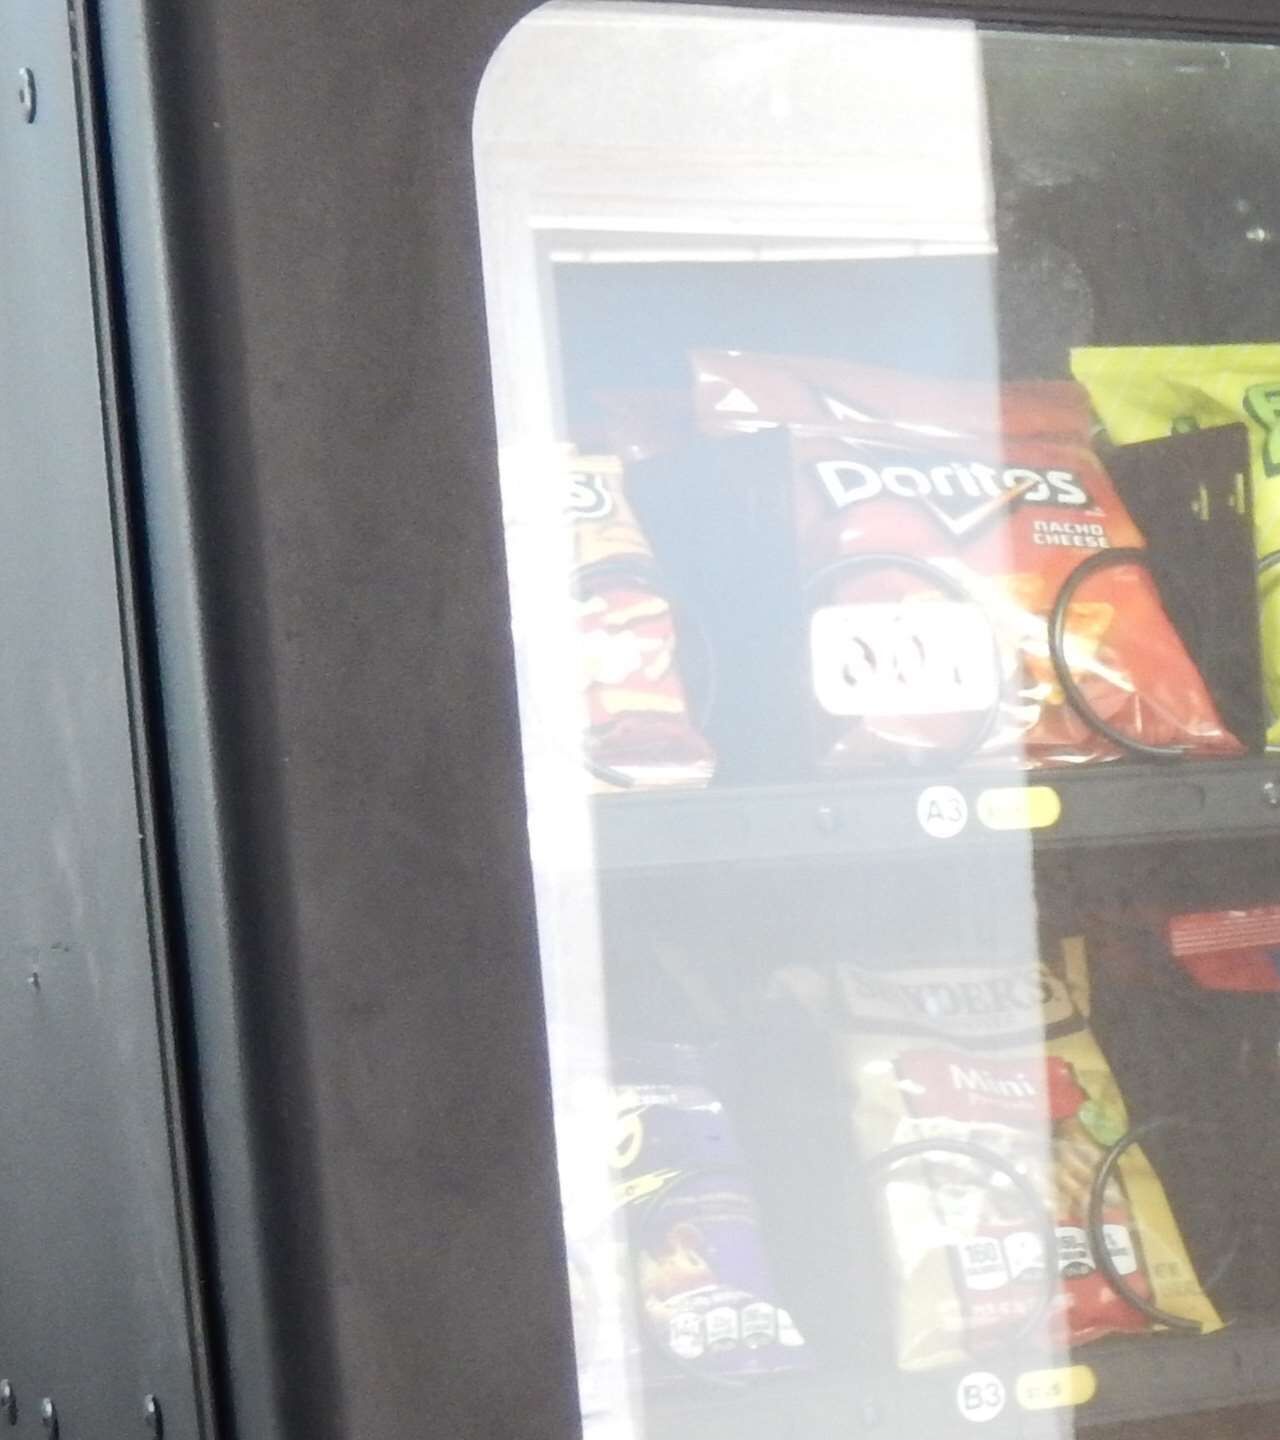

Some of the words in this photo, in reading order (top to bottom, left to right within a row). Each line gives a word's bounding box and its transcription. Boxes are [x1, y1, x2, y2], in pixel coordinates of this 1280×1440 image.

[816, 459, 1087, 509] Doritos
[1032, 520, 1104, 538] NACHO
[1032, 532, 1111, 550] CHEESE
[926, 795, 965, 825] A3
[963, 1383, 1003, 1411] B3
